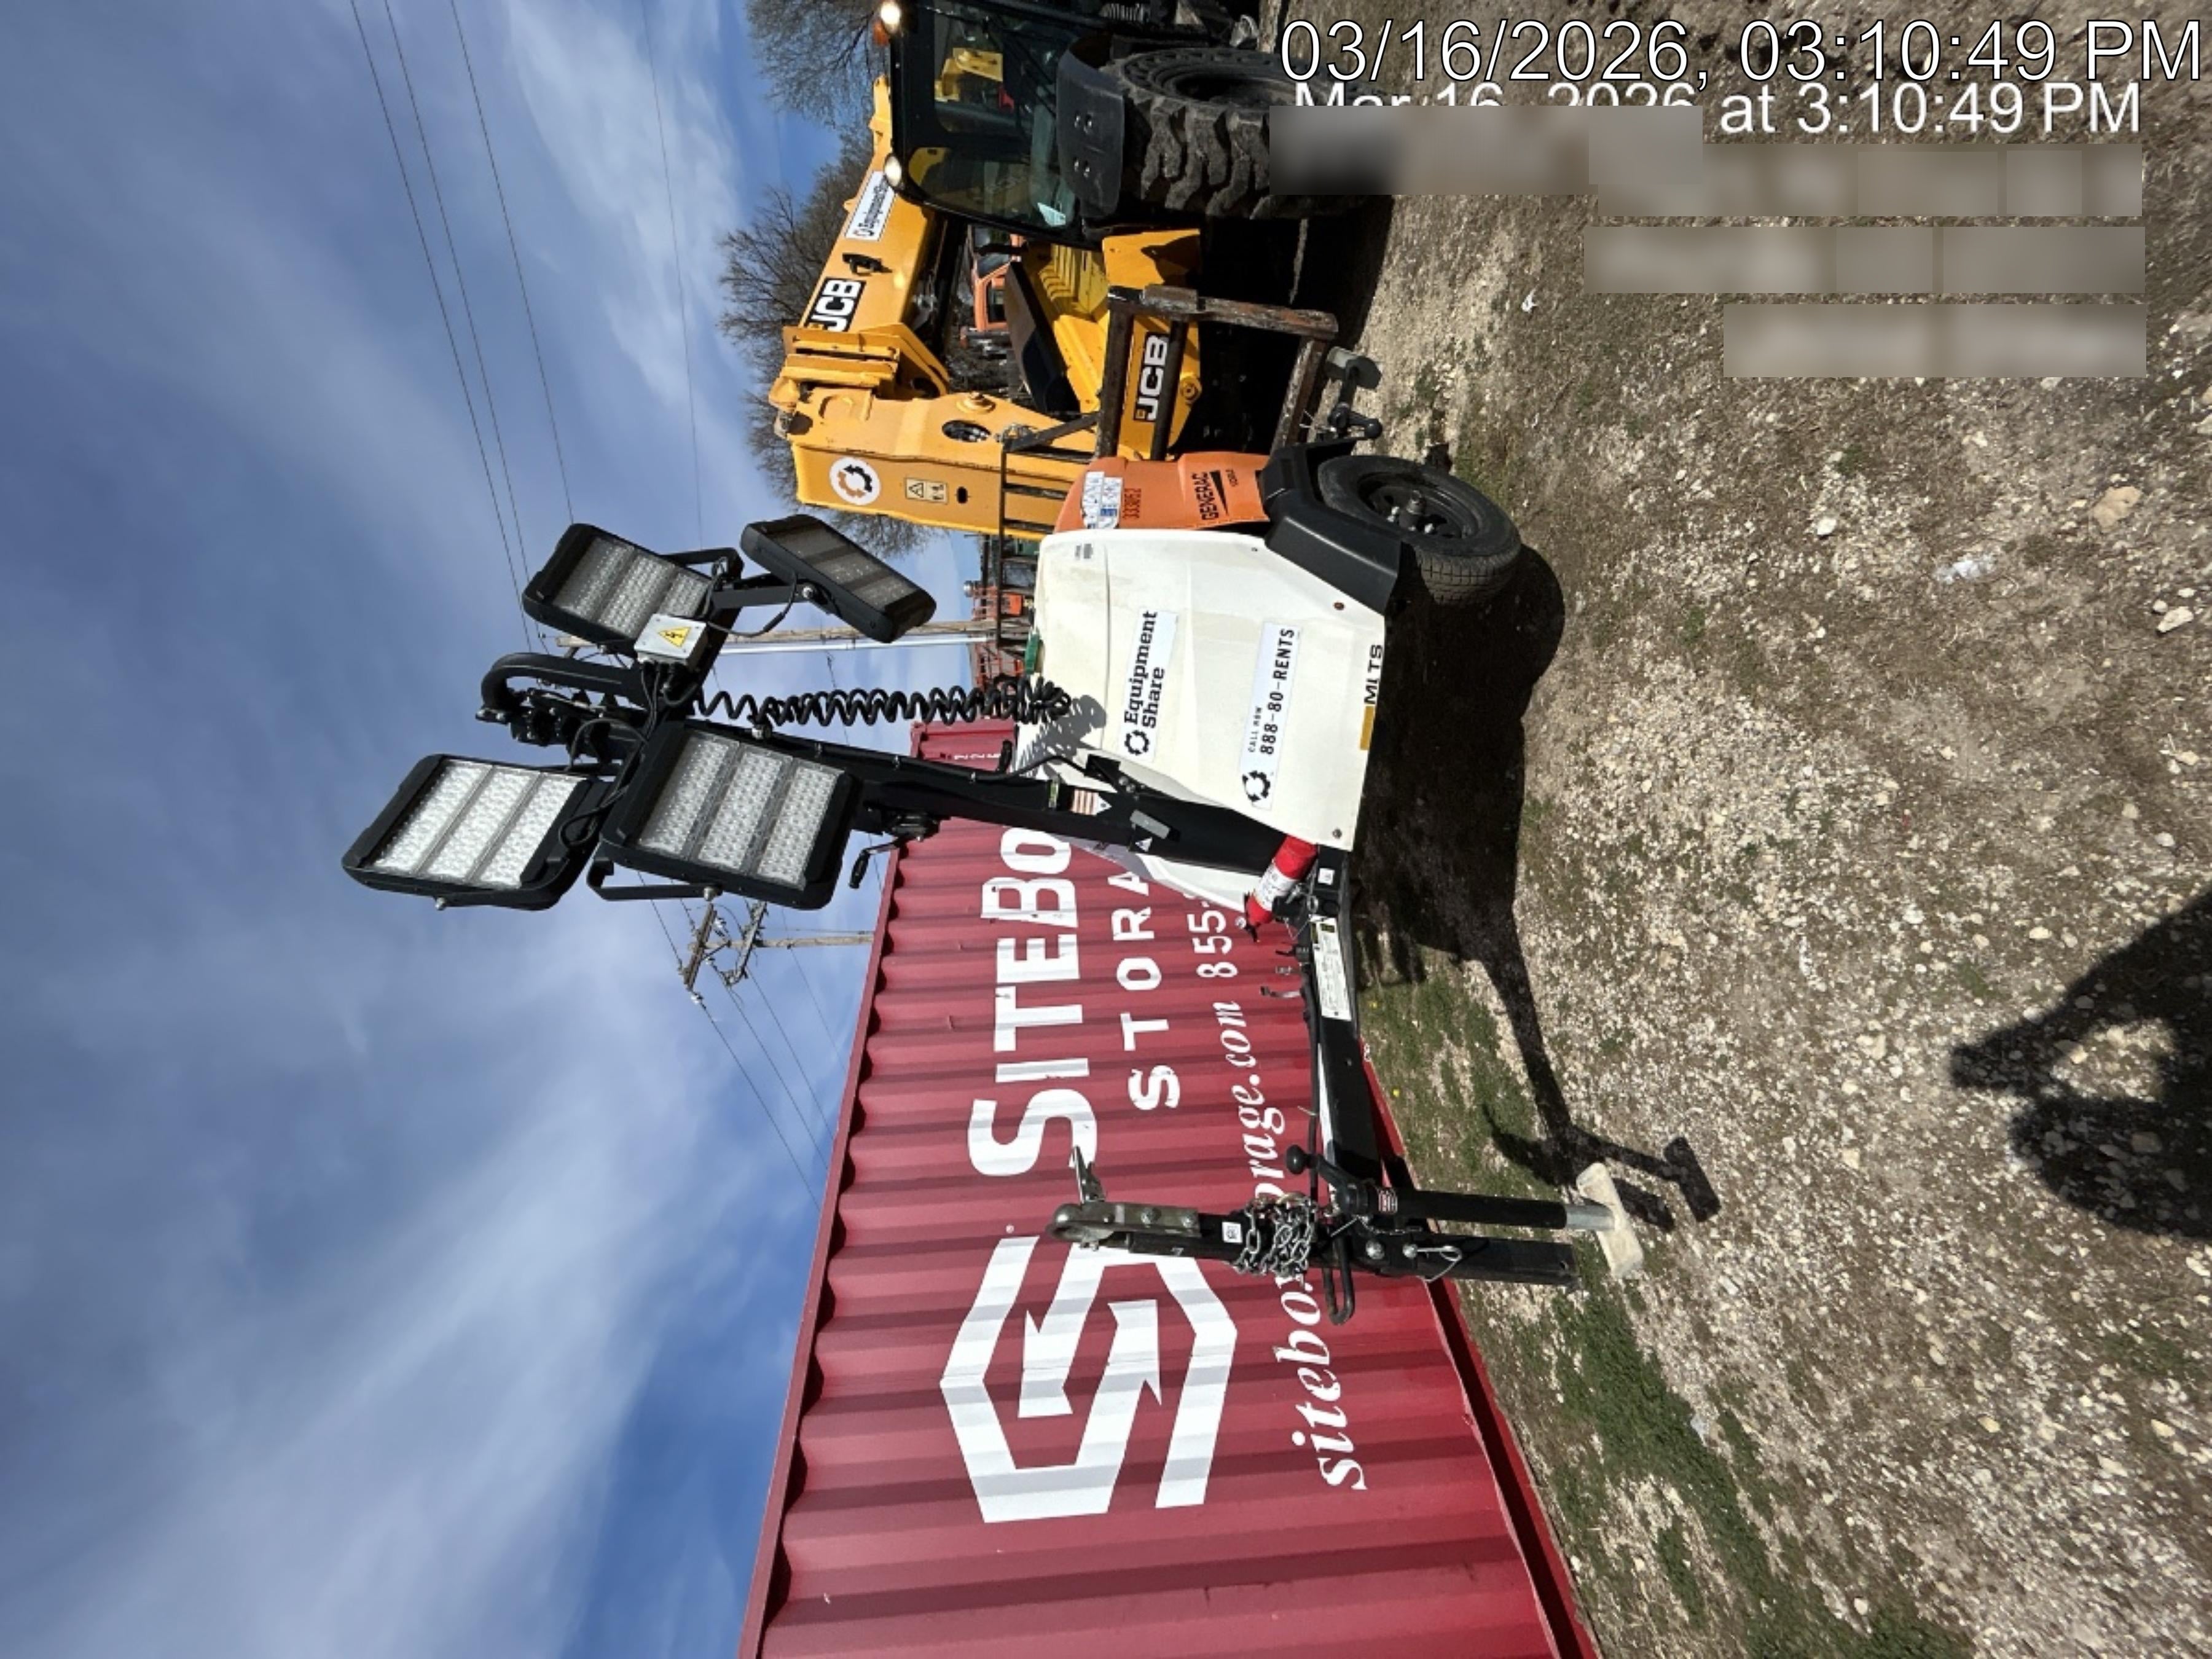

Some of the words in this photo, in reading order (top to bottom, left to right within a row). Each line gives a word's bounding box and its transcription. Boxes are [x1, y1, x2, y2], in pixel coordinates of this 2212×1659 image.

[810, 278, 861, 332] JCB
[1139, 334, 1168, 420] JCB
[1191, 471, 1220, 520] GENERAC
[1123, 610, 1157, 724] Equipment
[1142, 666, 1164, 728] Share
[1260, 628, 1294, 755] 888-80-RENTS
[1247, 730, 1258, 752] CALL
